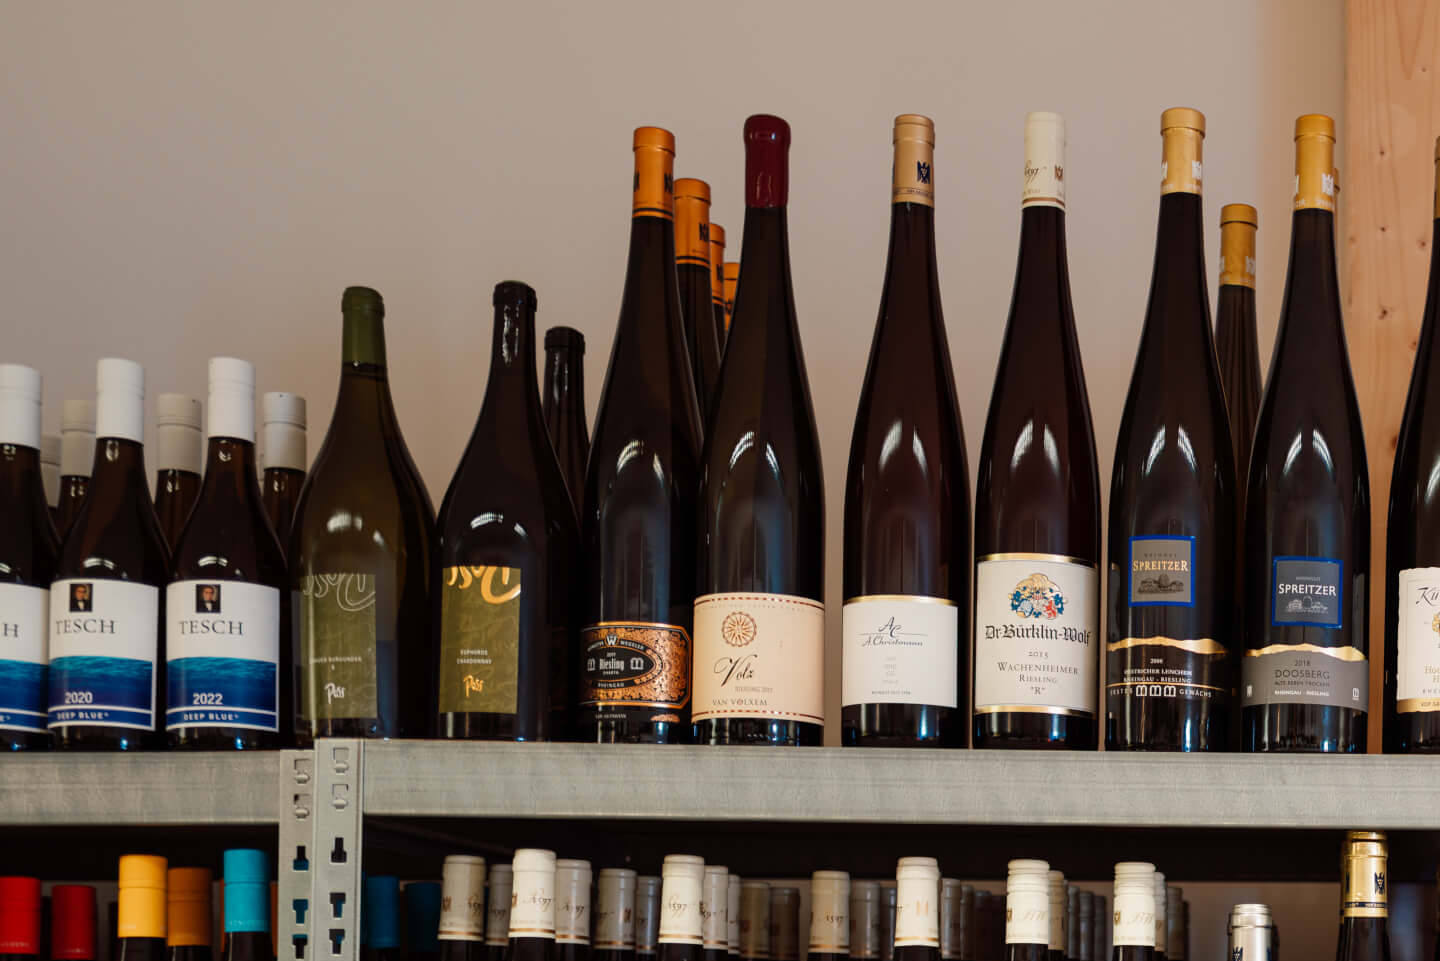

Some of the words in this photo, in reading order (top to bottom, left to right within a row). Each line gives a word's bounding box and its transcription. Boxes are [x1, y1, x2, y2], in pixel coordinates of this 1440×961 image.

[1133, 561, 1188, 572] SPREITZER
[1279, 583, 1336, 595] SPREITZER
[56, 619, 116, 634] TESCH
[180, 620, 244, 635] TESCH
[600, 658, 625, 670] Riesling
[998, 662, 1079, 675] WACHENHEIMER
[714, 654, 758, 687] Volz
[1275, 669, 1330, 680] DOOSBERG
[1019, 674, 1057, 684] RIESLING
[65, 692, 92, 703] 2020
[193, 693, 223, 705] 2022
[712, 698, 727, 707] VAN
[731, 698, 768, 707] VOLXEM
